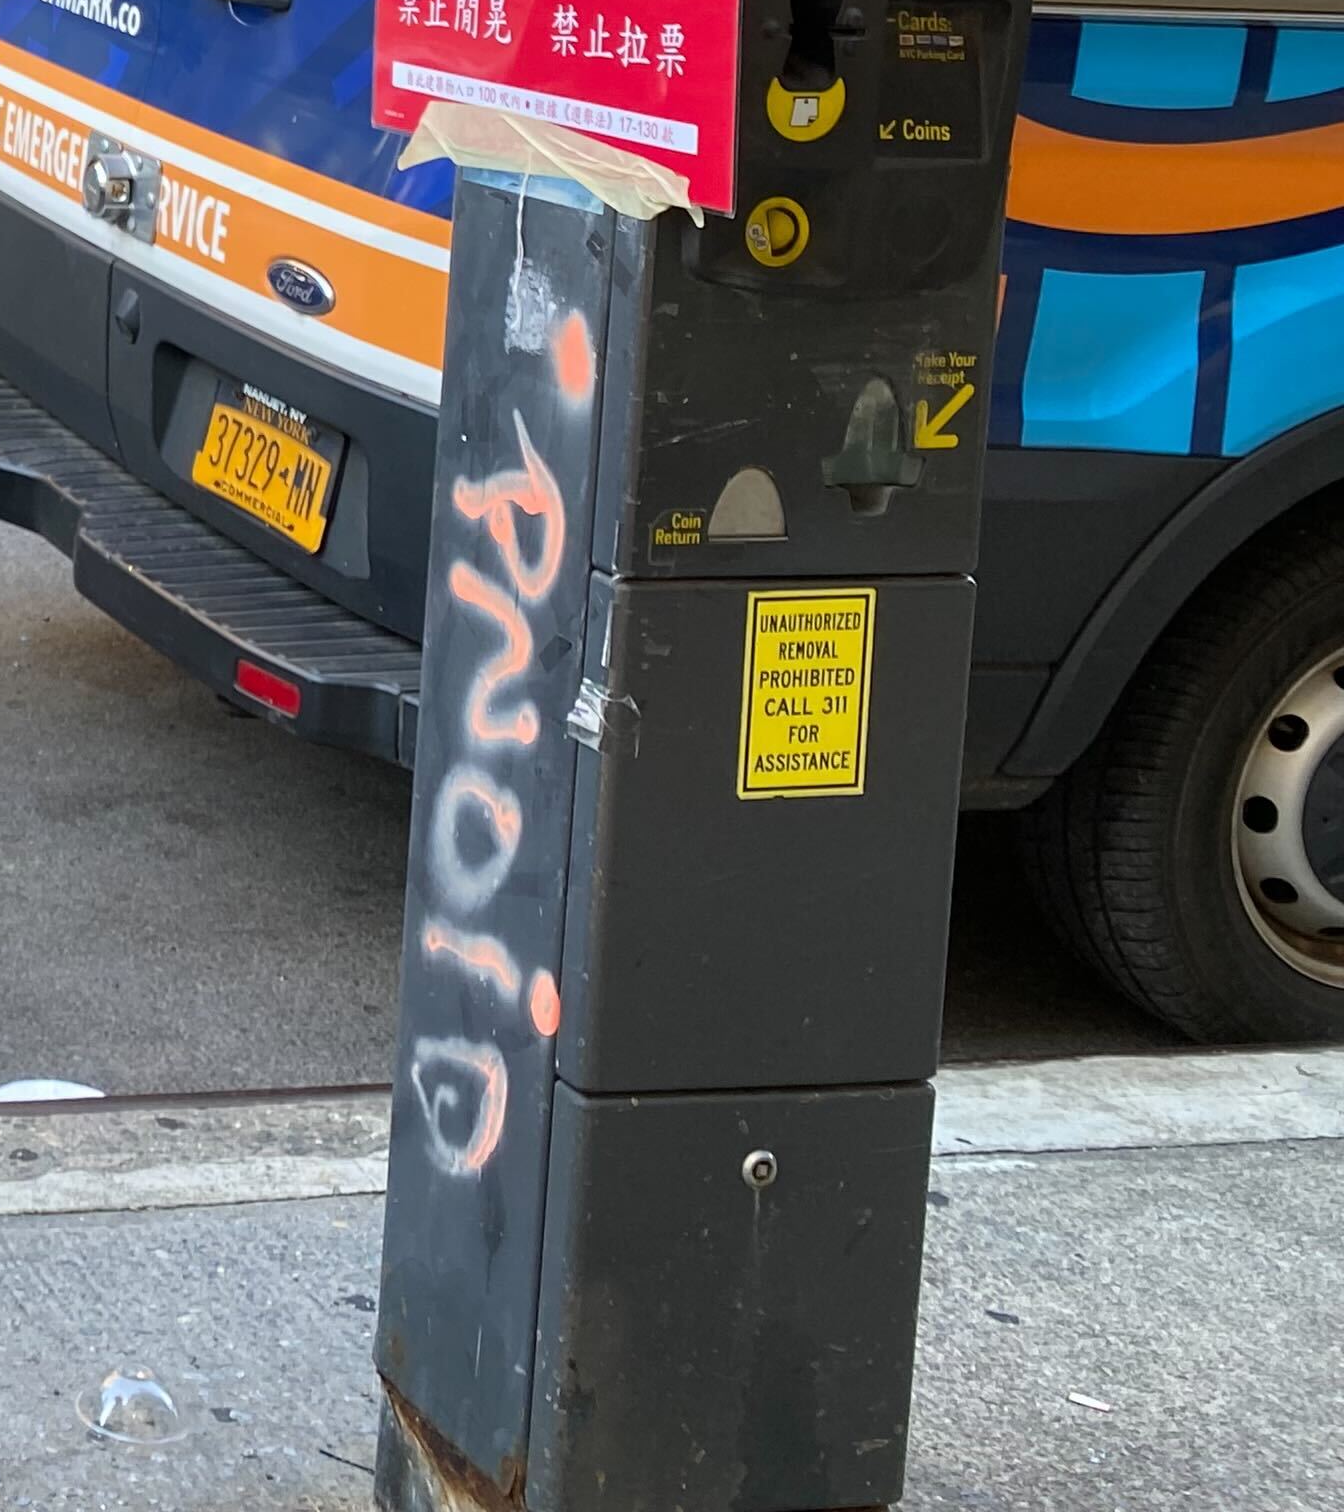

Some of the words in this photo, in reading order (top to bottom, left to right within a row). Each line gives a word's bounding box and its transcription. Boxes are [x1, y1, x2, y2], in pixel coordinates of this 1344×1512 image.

[898, 11, 952, 32] Cards:
[551, 4, 687, 78] 禁止拉票
[903, 119, 951, 140] Coins
[4, 102, 89, 192] EMERGE
[156, 176, 230, 263] RVICE
[276, 268, 314, 304] Ford
[917, 353, 946, 367] Take
[949, 352, 976, 368] Your
[243, 398, 272, 424] NEW
[276, 410, 311, 446] YORK
[288, 406, 306, 424] NY
[221, 482, 288, 528] COMMERCIAL
[672, 512, 701, 529] Coin
[655, 529, 700, 545] Return
[760, 612, 861, 633] UNAUTHORIZED
[779, 641, 838, 660] REMOVAL
[760, 668, 854, 688] PROHIBITED
[764, 698, 812, 716] CALL
[822, 696, 847, 714] 311
[789, 725, 819, 743] FOR
[755, 751, 850, 773] ASSISTANCE
